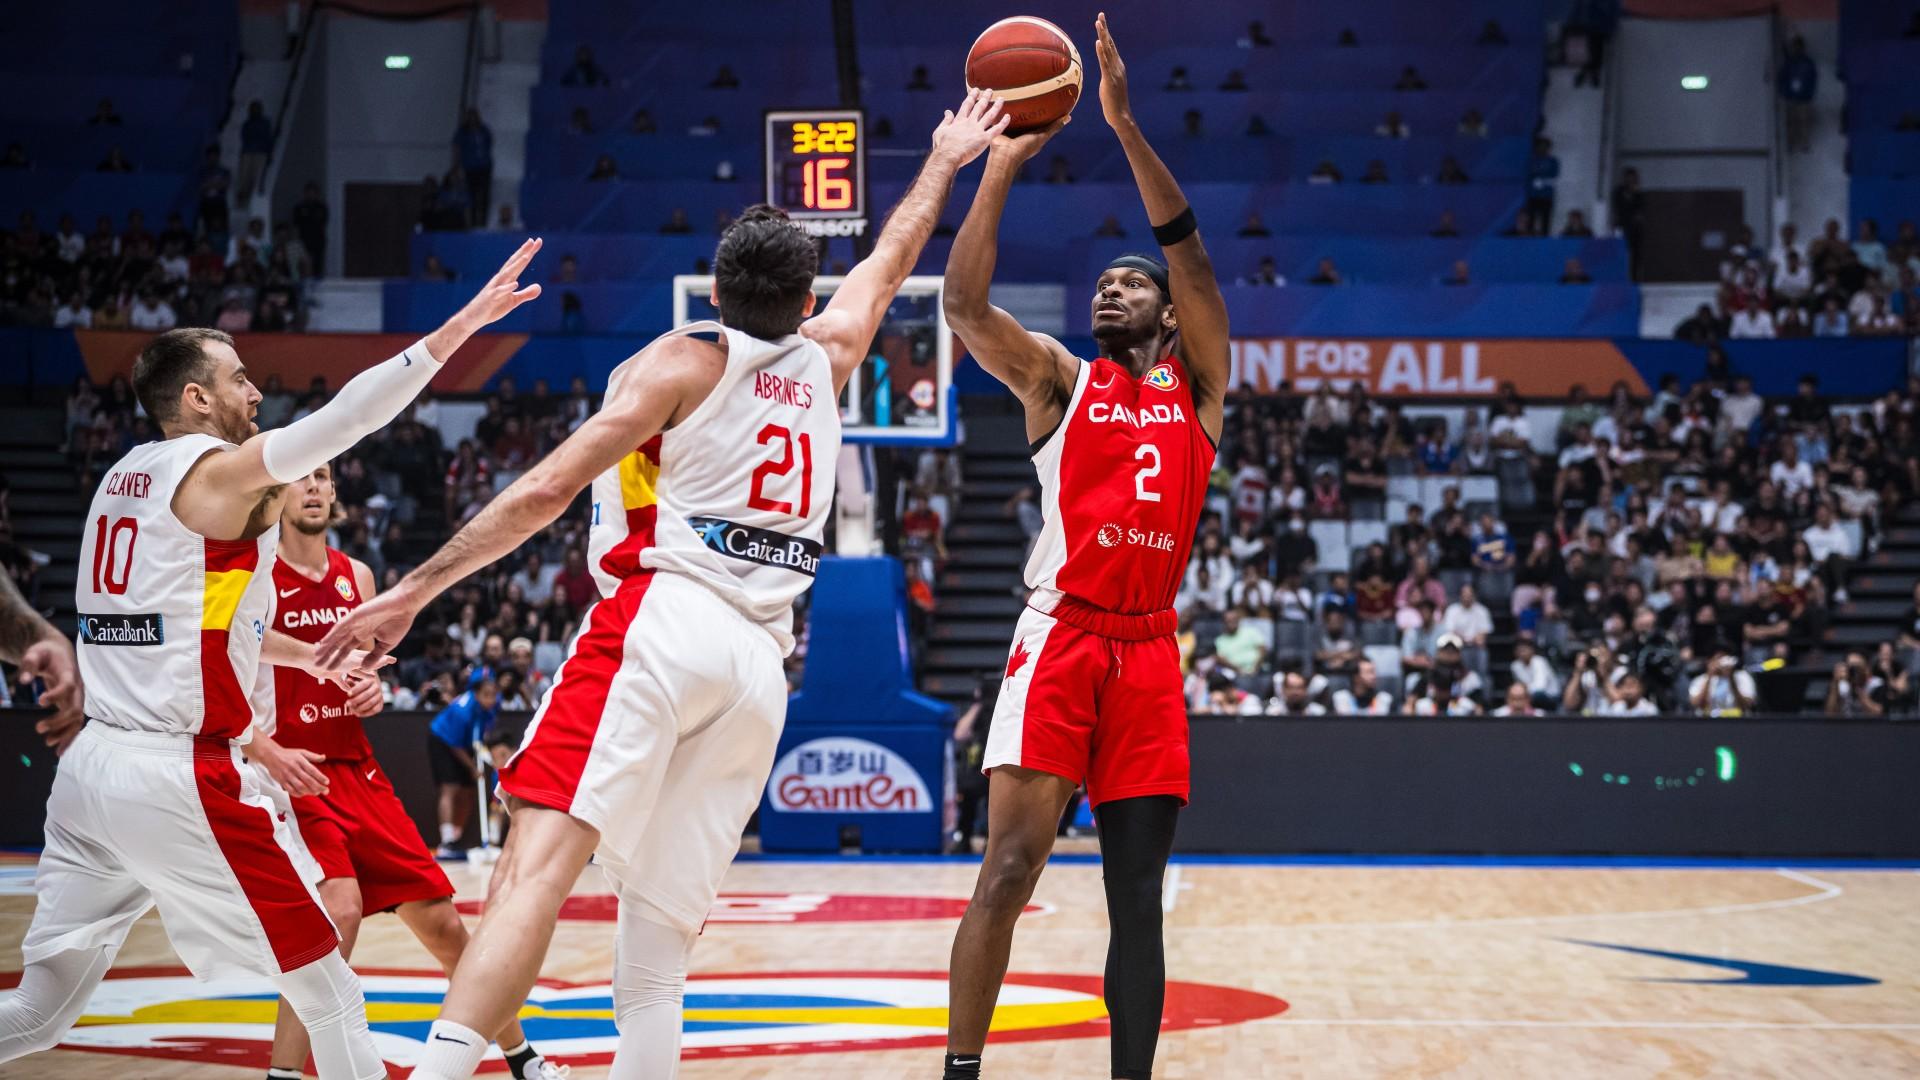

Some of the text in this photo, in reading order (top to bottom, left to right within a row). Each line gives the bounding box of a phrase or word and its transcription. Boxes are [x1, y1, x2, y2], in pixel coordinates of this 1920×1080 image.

[792, 122, 856, 153] 3:22
[803, 158, 852, 210] 16
[1296, 342, 1370, 373] FOR
[1378, 342, 1495, 392] ALL
[754, 369, 813, 410] ABRINES
[1088, 402, 1186, 429] CANADA
[106, 472, 152, 499] CLAVER
[747, 423, 813, 519] 21
[1134, 443, 1162, 503] 2
[93, 514, 139, 596] 10
[725, 528, 820, 573] CaixaBan
[1147, 531, 1175, 552] Life
[87, 617, 160, 642] CaixaBank
[284, 606, 356, 628] CANAD
[321, 705, 342, 719] Sun
